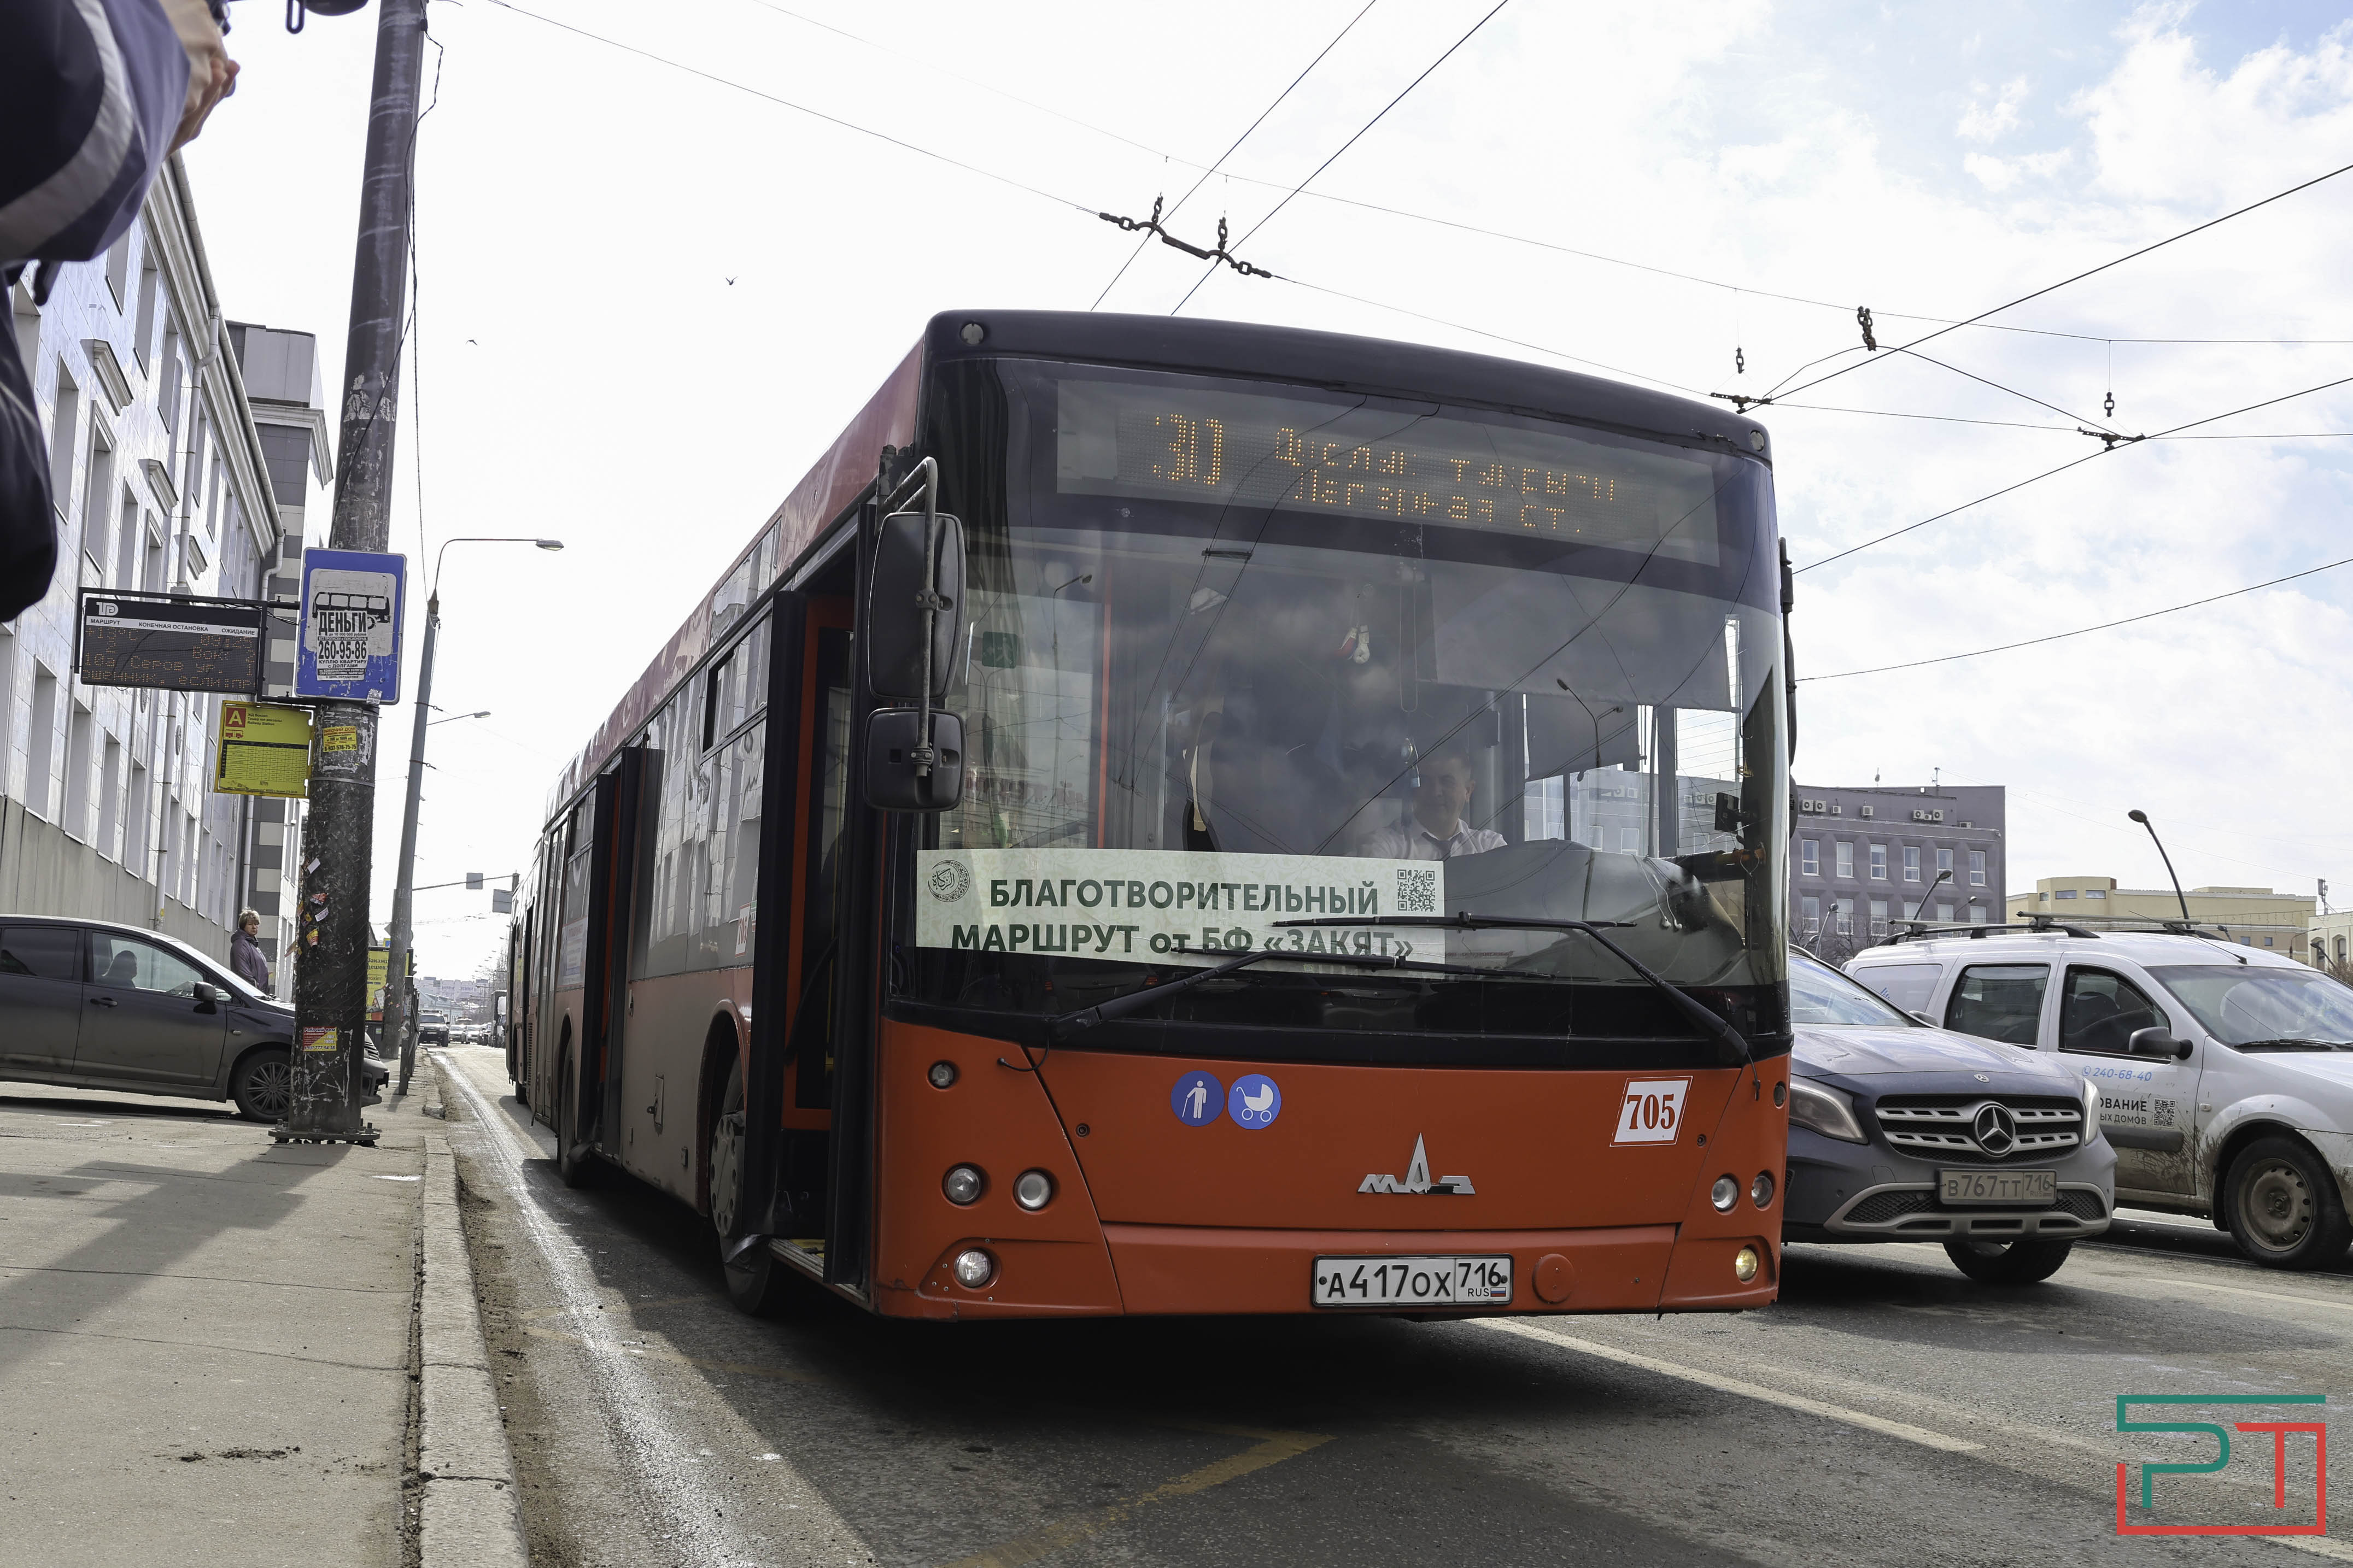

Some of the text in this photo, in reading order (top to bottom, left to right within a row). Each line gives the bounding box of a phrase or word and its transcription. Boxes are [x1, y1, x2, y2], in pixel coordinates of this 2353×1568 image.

[318, 612, 366, 636] ДЕНЬГИ
[106, 641, 116, 653] 2
[318, 641, 367, 659] 260-95-86
[131, 656, 184, 671] Серов
[991, 879, 1378, 915] БЛАГОТВОРИТЕЛЬНЫЙ
[951, 924, 1139, 953] МАРШРУТ
[1149, 932, 1191, 954] от
[1203, 927, 1253, 952] БФ
[2093, 1067, 2152, 1081] 240-68-40
[1626, 1093, 1676, 1131] 705
[2114, 1114, 2146, 1124] ДОМОВ
[1948, 1174, 2050, 1197] В767ТТ 716
[1327, 1261, 1501, 1298] А417ОХ 716
[1467, 1288, 1490, 1297] RUS
